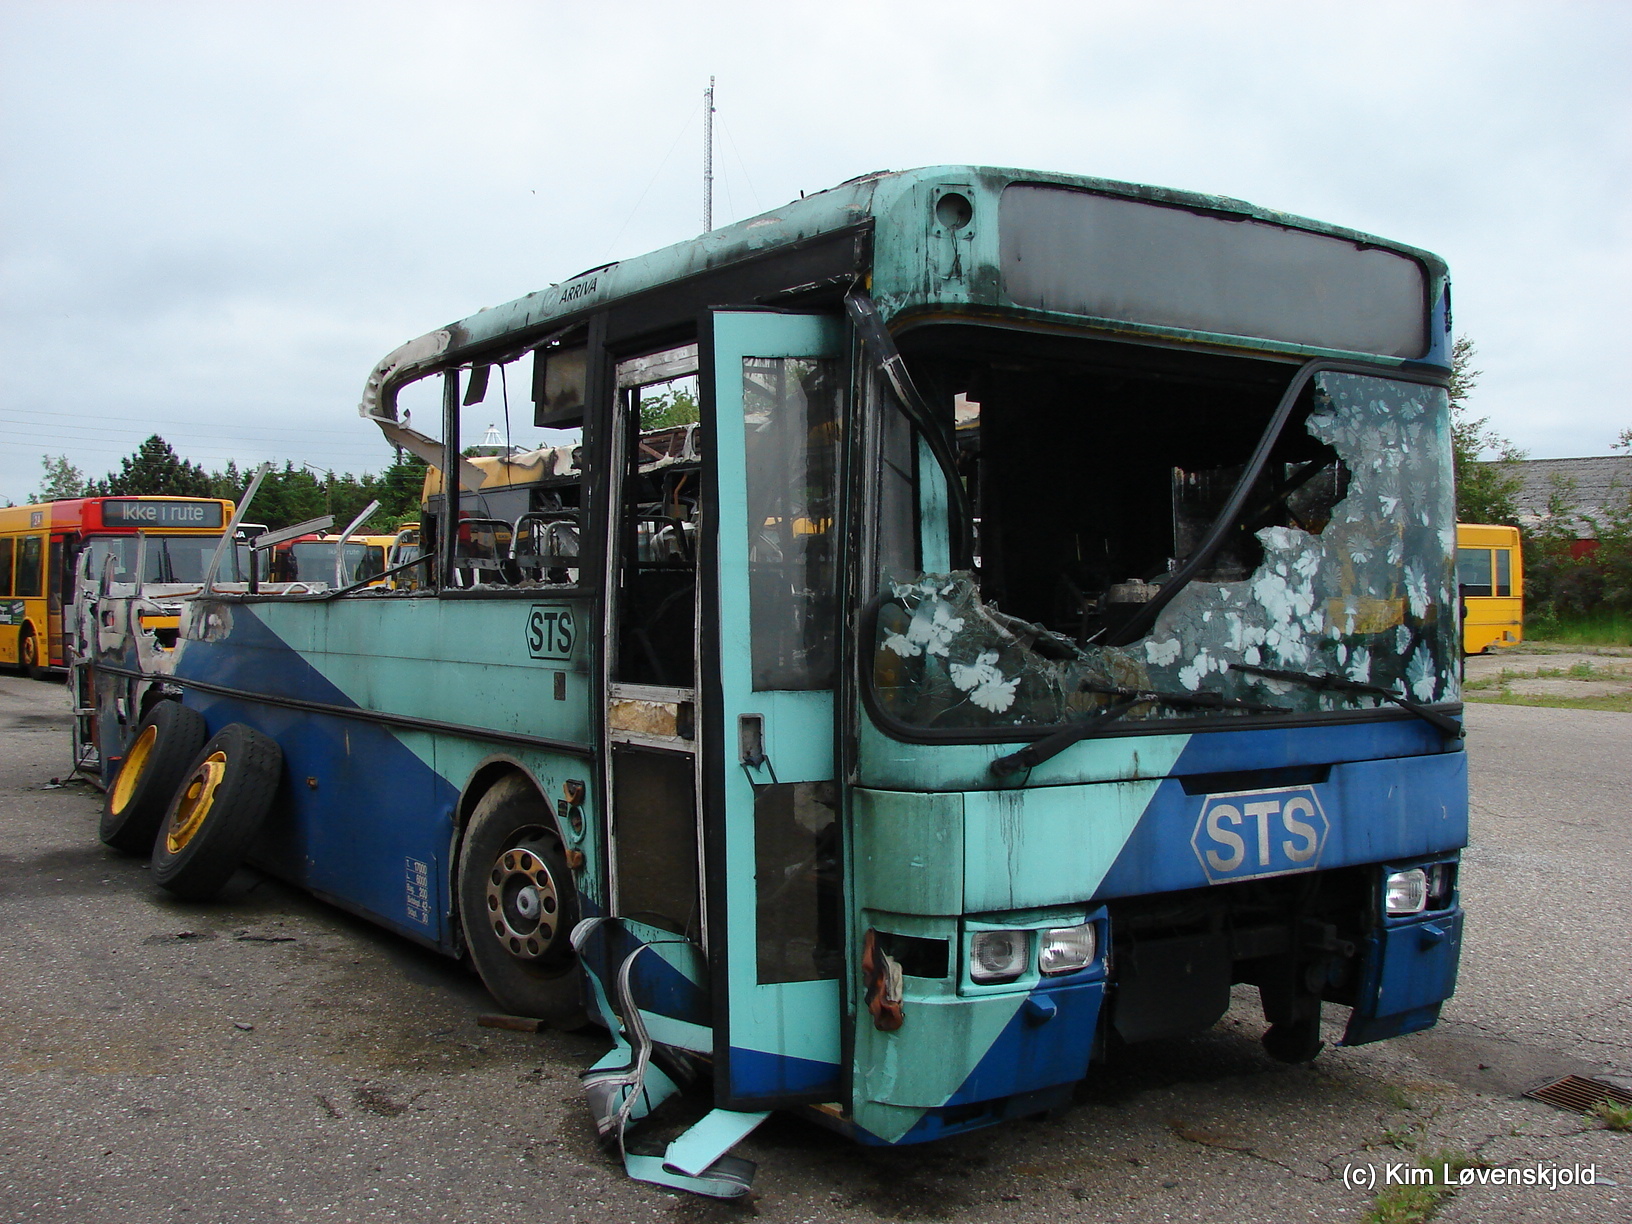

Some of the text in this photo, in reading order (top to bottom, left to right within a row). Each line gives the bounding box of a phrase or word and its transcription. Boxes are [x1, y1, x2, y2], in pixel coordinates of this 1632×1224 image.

[559, 277, 597, 305] ARRIVA
[122, 502, 204, 520] Ikke i rute
[530, 611, 572, 653] STS
[1206, 797, 1317, 872] STS
